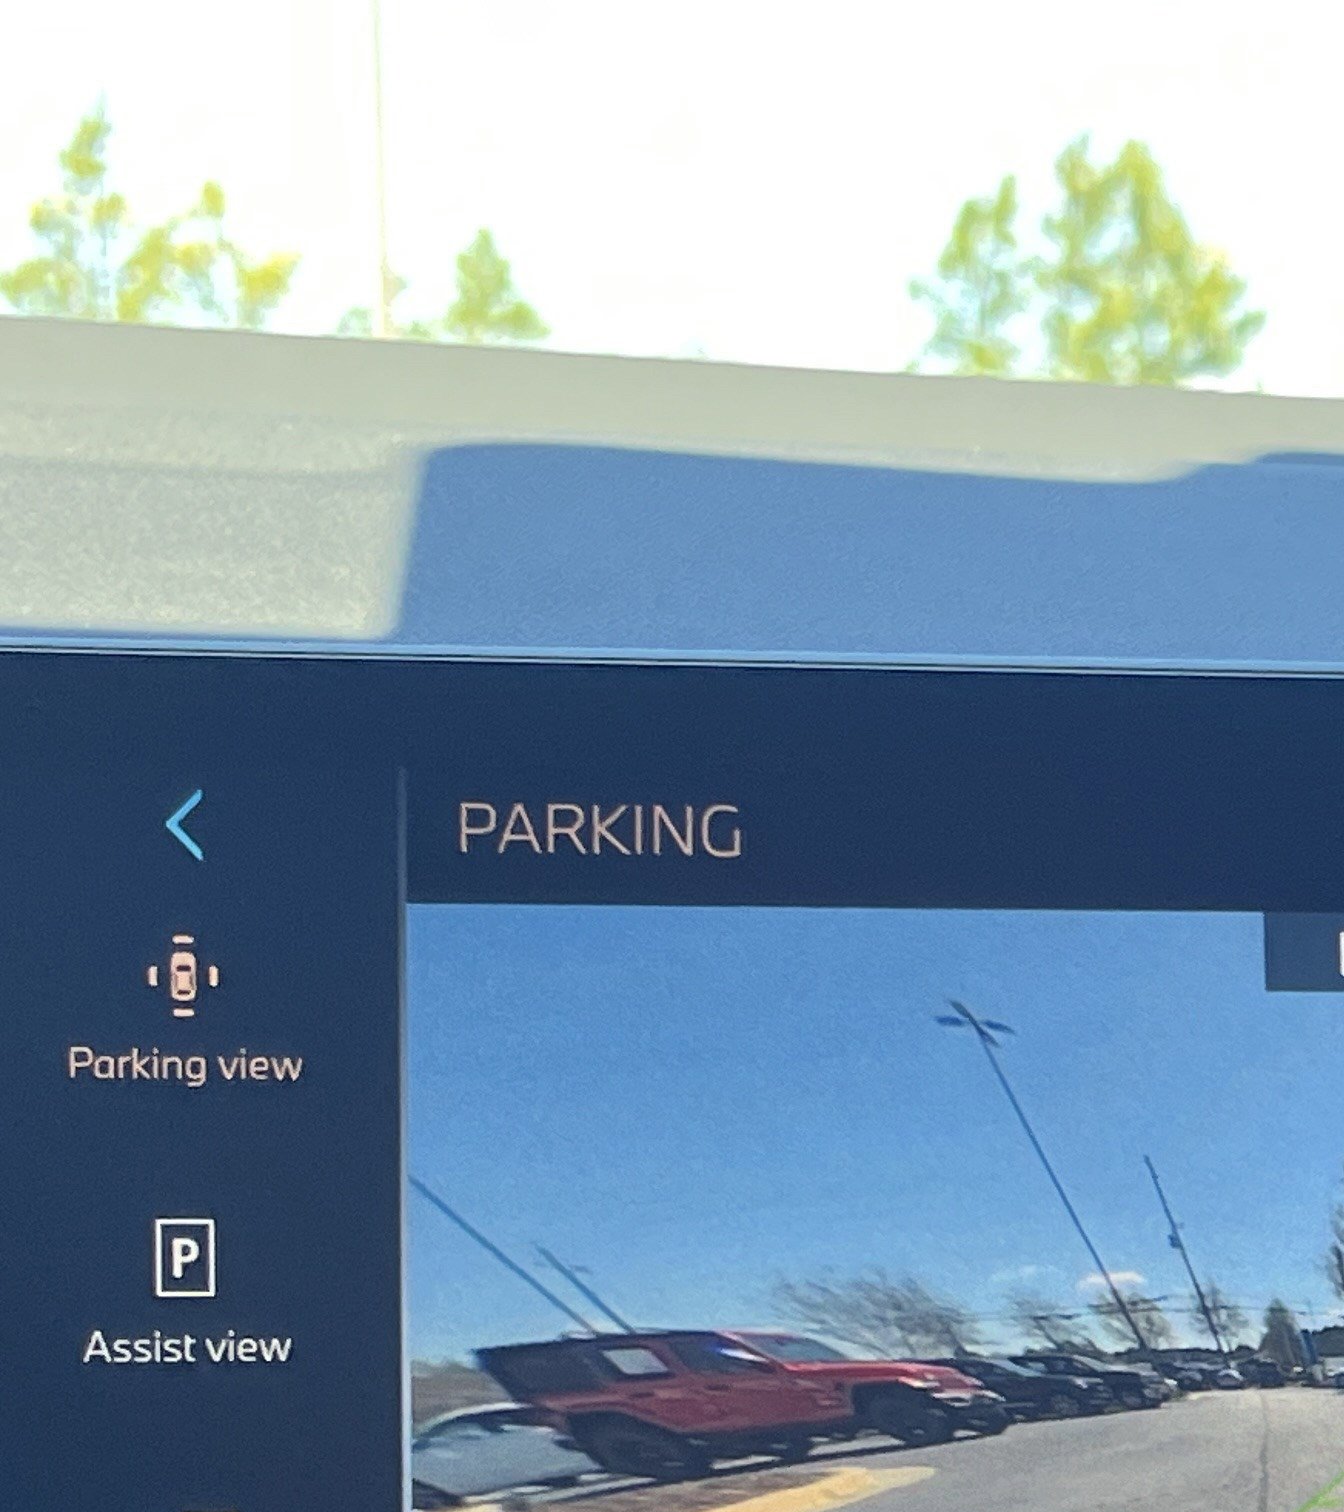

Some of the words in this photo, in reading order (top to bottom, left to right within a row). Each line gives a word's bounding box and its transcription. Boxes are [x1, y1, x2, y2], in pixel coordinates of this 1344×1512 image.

[459, 802, 743, 858] PARKING
[68, 1046, 206, 1086] Parking
[217, 1048, 303, 1082] view
[171, 1237, 199, 1278] P
[83, 1330, 196, 1364] Assist
[205, 1332, 292, 1363] view
